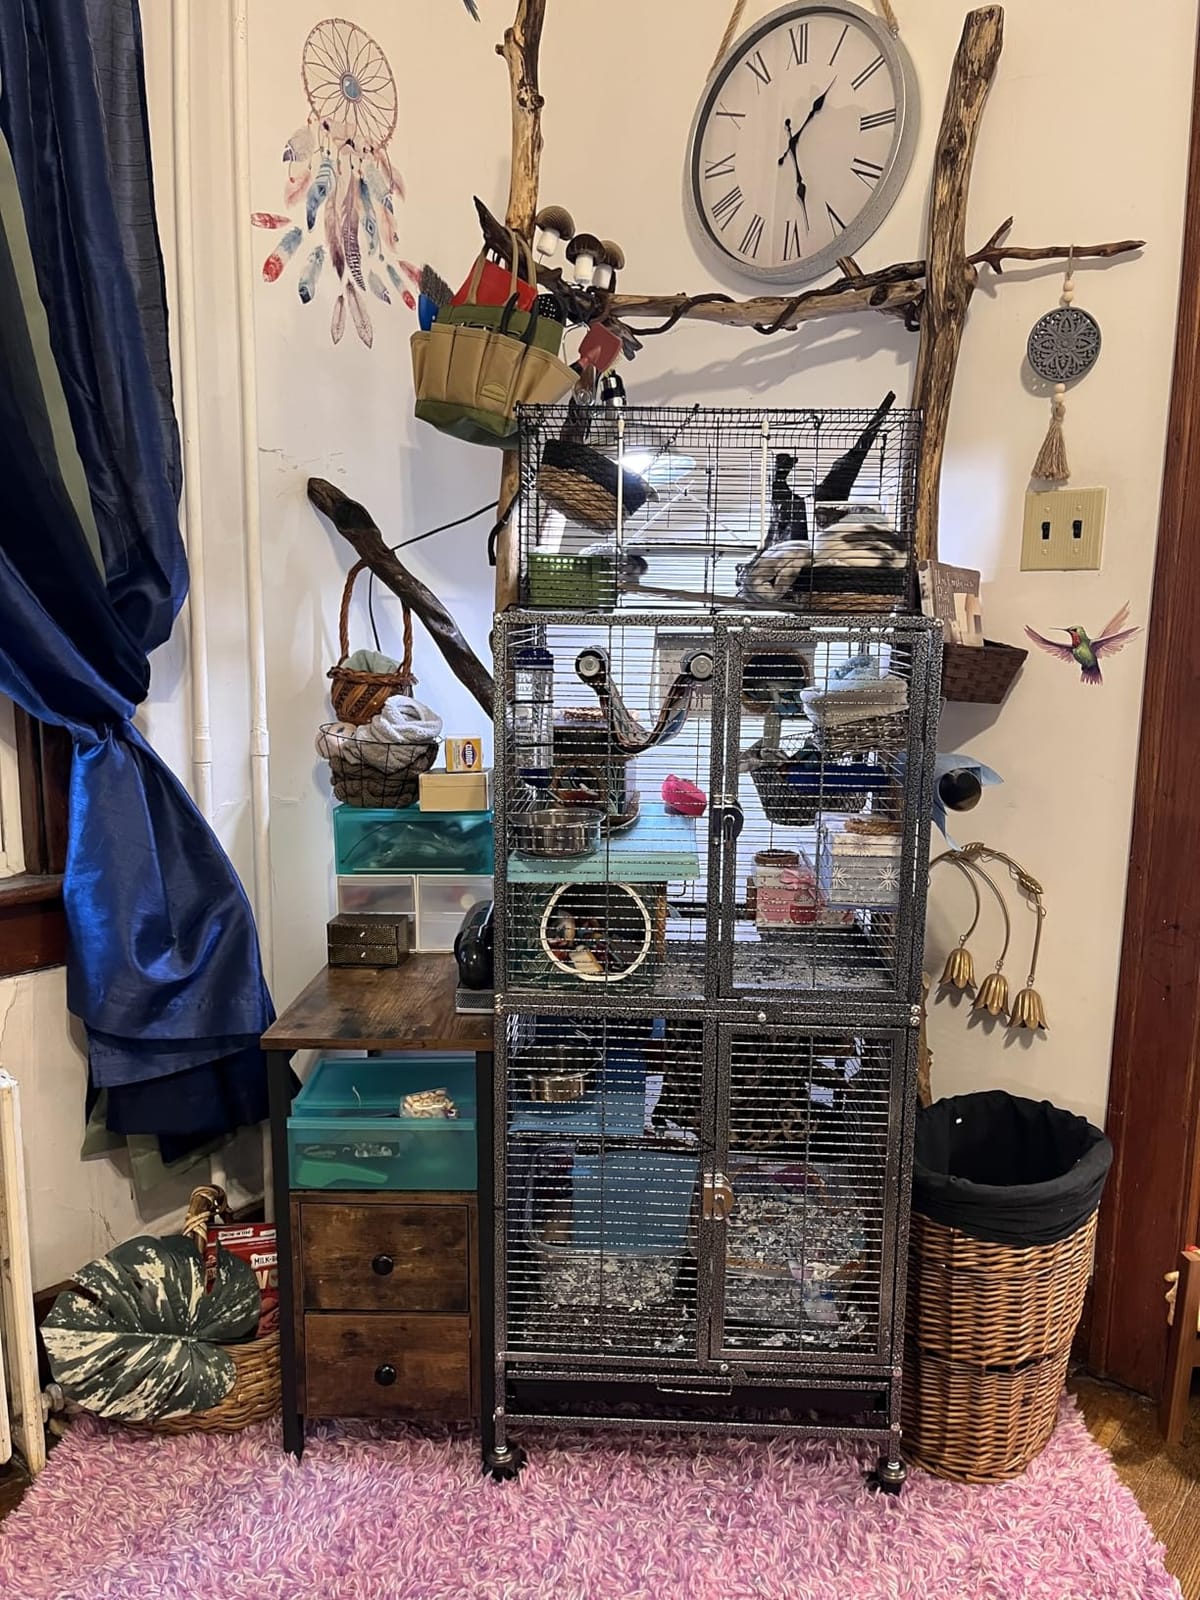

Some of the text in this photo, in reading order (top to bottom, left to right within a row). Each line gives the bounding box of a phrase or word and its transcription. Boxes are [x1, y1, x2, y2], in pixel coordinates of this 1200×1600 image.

[786, 22, 809, 71] XII
[827, 24, 849, 66] I
[744, 50, 772, 95] XI
[850, 54, 886, 91] II
[715, 102, 746, 130] X
[859, 108, 897, 131] III
[704, 153, 736, 180] IX
[711, 185, 745, 232] VIII
[825, 201, 846, 239] V
[737, 214, 766, 259] VII
[783, 218, 802, 261] VI
